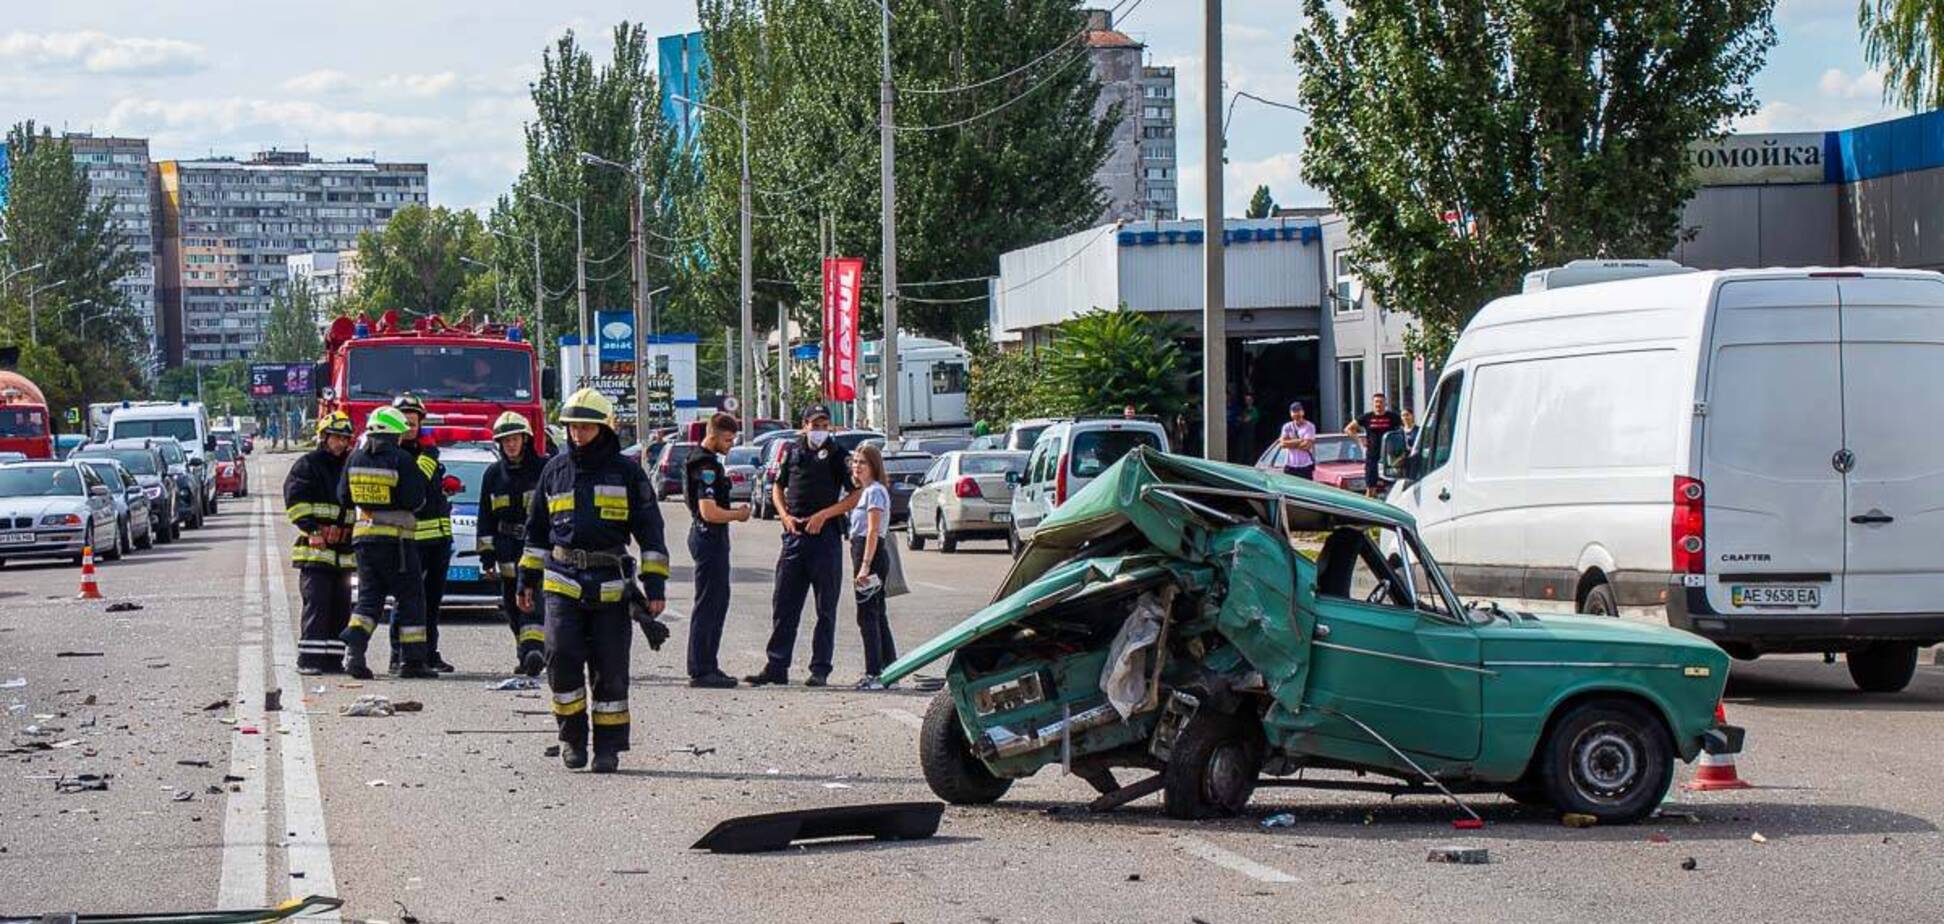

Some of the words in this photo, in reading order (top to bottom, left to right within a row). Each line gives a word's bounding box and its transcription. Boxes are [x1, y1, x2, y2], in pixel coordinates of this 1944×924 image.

[840, 268, 856, 391] MOTUL
[1743, 589, 1761, 602] AE
[1765, 589, 1794, 602] 9658
[1797, 589, 1817, 603] EA
